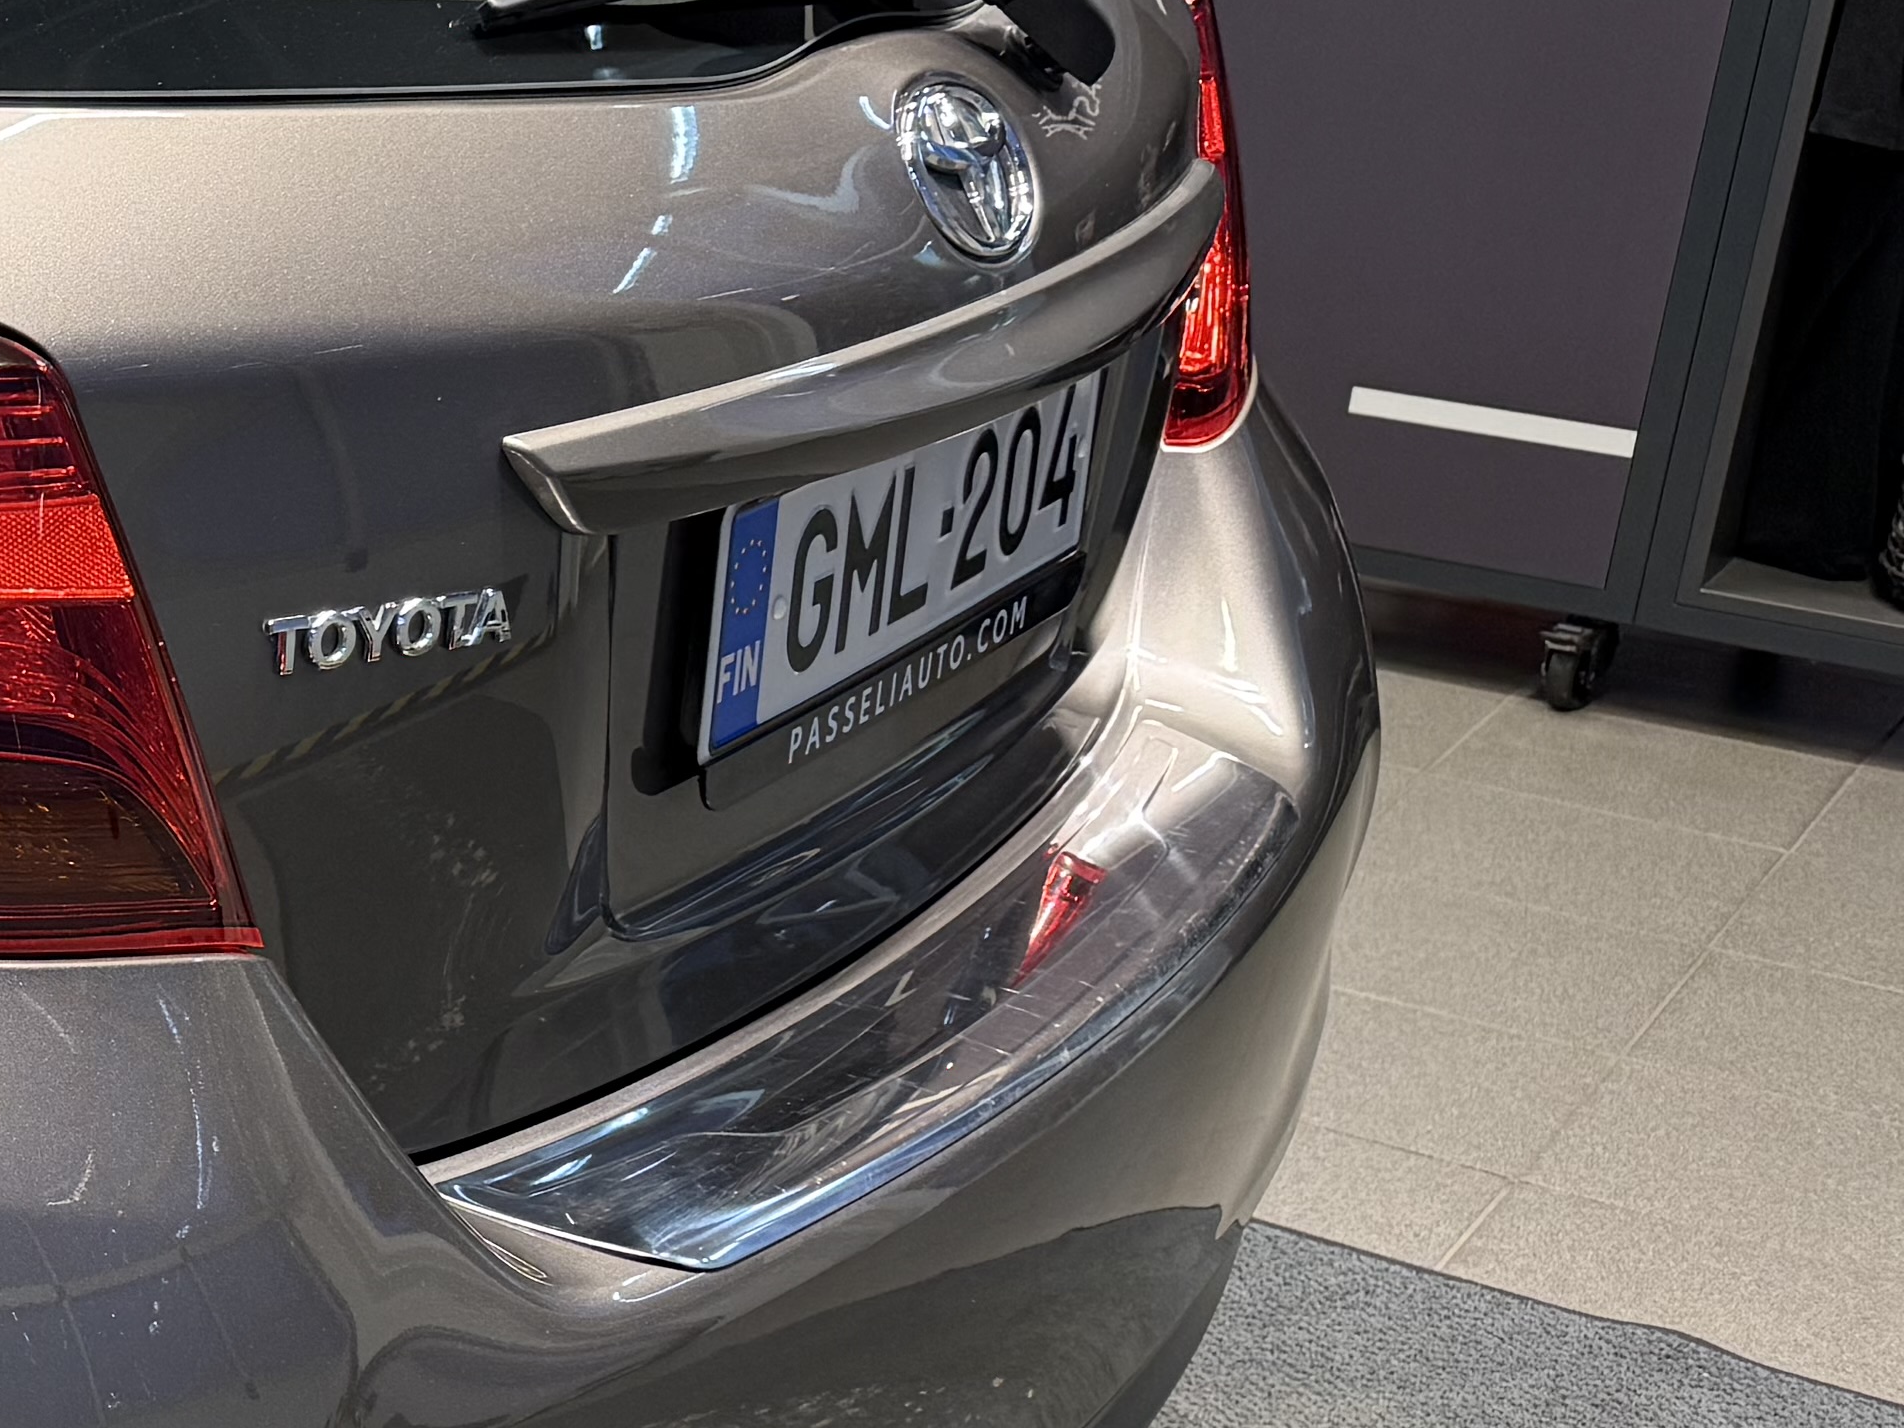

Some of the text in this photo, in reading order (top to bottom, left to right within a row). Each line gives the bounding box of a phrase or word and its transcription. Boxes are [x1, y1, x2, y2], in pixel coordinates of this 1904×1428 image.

[786, 384, 1078, 673] GML-204
[262, 586, 512, 676] TOYOTA
[715, 639, 761, 704] FIN
[789, 595, 1028, 764] PASSELIAUTO.COM
